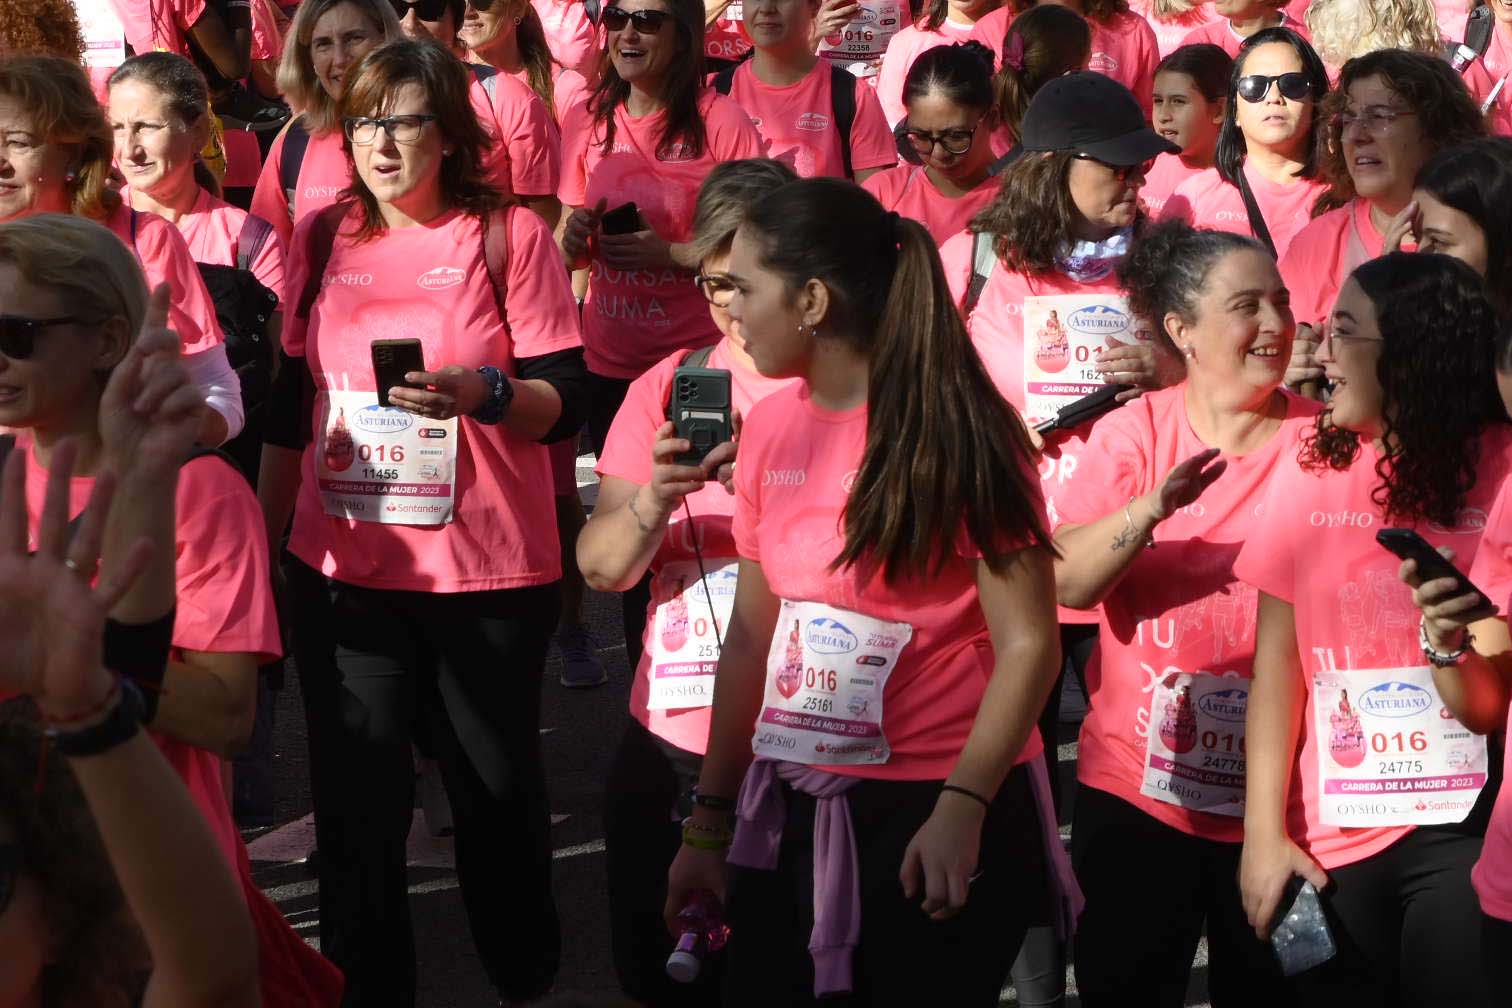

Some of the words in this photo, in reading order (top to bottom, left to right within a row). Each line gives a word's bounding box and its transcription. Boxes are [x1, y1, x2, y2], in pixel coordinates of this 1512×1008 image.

[844, 30, 873, 42] 016
[847, 44, 870, 52] 22358
[595, 295, 666, 320] SUMA
[1072, 314, 1126, 329] ASTURIANA
[1075, 345, 1103, 362] 01
[1042, 385, 1080, 393] CARRERA
[356, 414, 408, 427] ASTURIANA
[358, 444, 405, 463] 016
[362, 468, 399, 480] 11455
[389, 485, 418, 494] MUJER
[420, 486, 440, 494] 2023
[398, 503, 443, 513] Santander
[809, 631, 851, 651] ASTURIANA
[664, 664, 701, 675] CARRERA
[703, 663, 714, 673] DE
[805, 667, 838, 692] 016
[803, 696, 834, 713] 25161
[1365, 695, 1427, 710] ASTURIANA
[773, 712, 802, 726] CARRERA
[802, 717, 811, 726] DE
[811, 718, 823, 728] LA
[824, 720, 846, 732] MUJER
[1371, 730, 1428, 753] 016
[1379, 760, 1423, 775] 24775
[1157, 778, 1202, 801] OYSHO
[1341, 780, 1383, 791] CARRERA
[1385, 780, 1398, 791] DE
[1400, 780, 1413, 790] LA
[1415, 779, 1448, 790] MUJER
[1451, 778, 1474, 787] 2023
[1337, 803, 1387, 815] OYSHO
